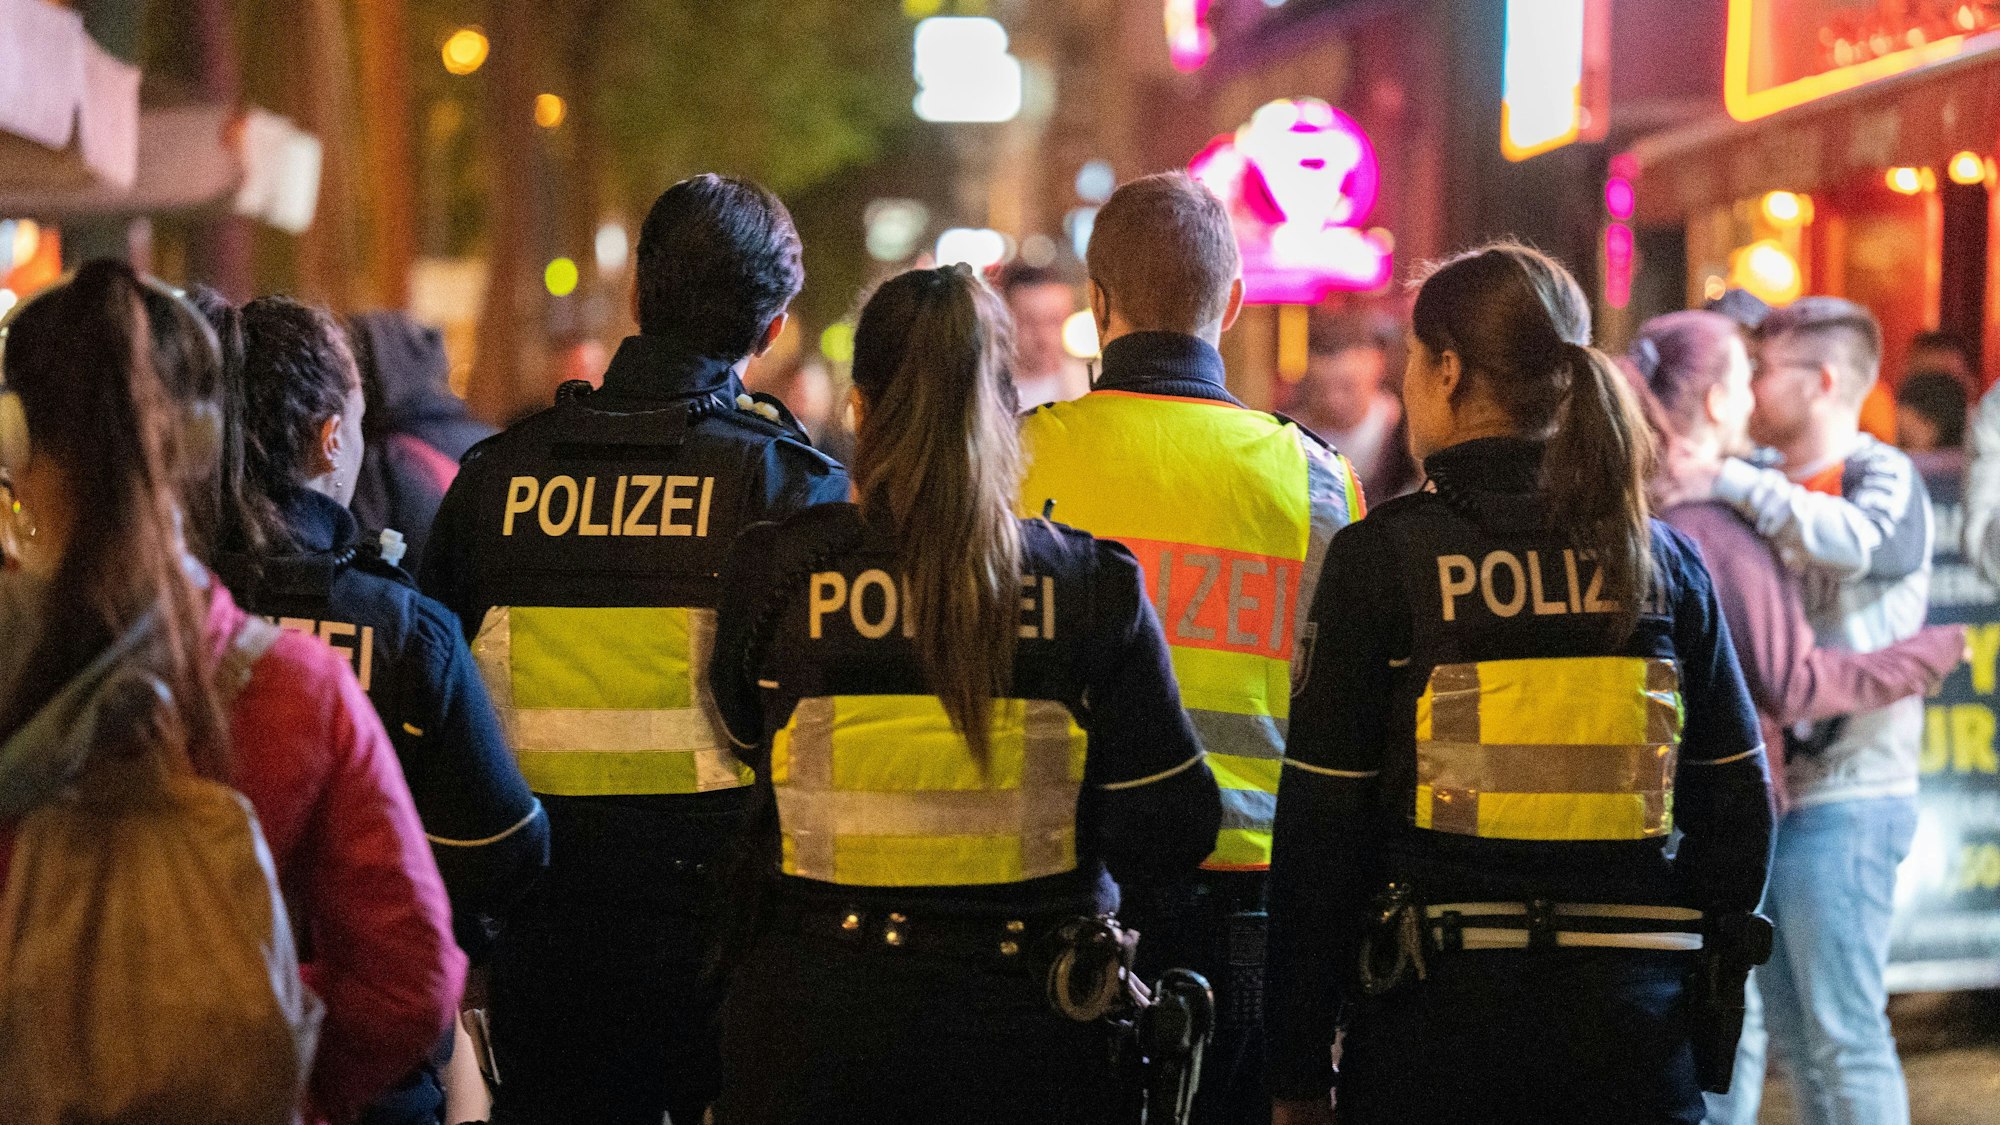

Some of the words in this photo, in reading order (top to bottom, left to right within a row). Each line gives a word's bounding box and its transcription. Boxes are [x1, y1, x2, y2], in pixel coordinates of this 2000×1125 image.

[503, 475, 715, 537] POLIZEI
[1155, 550, 1289, 651] IZEI
[1437, 549, 1666, 621] POLIZ
